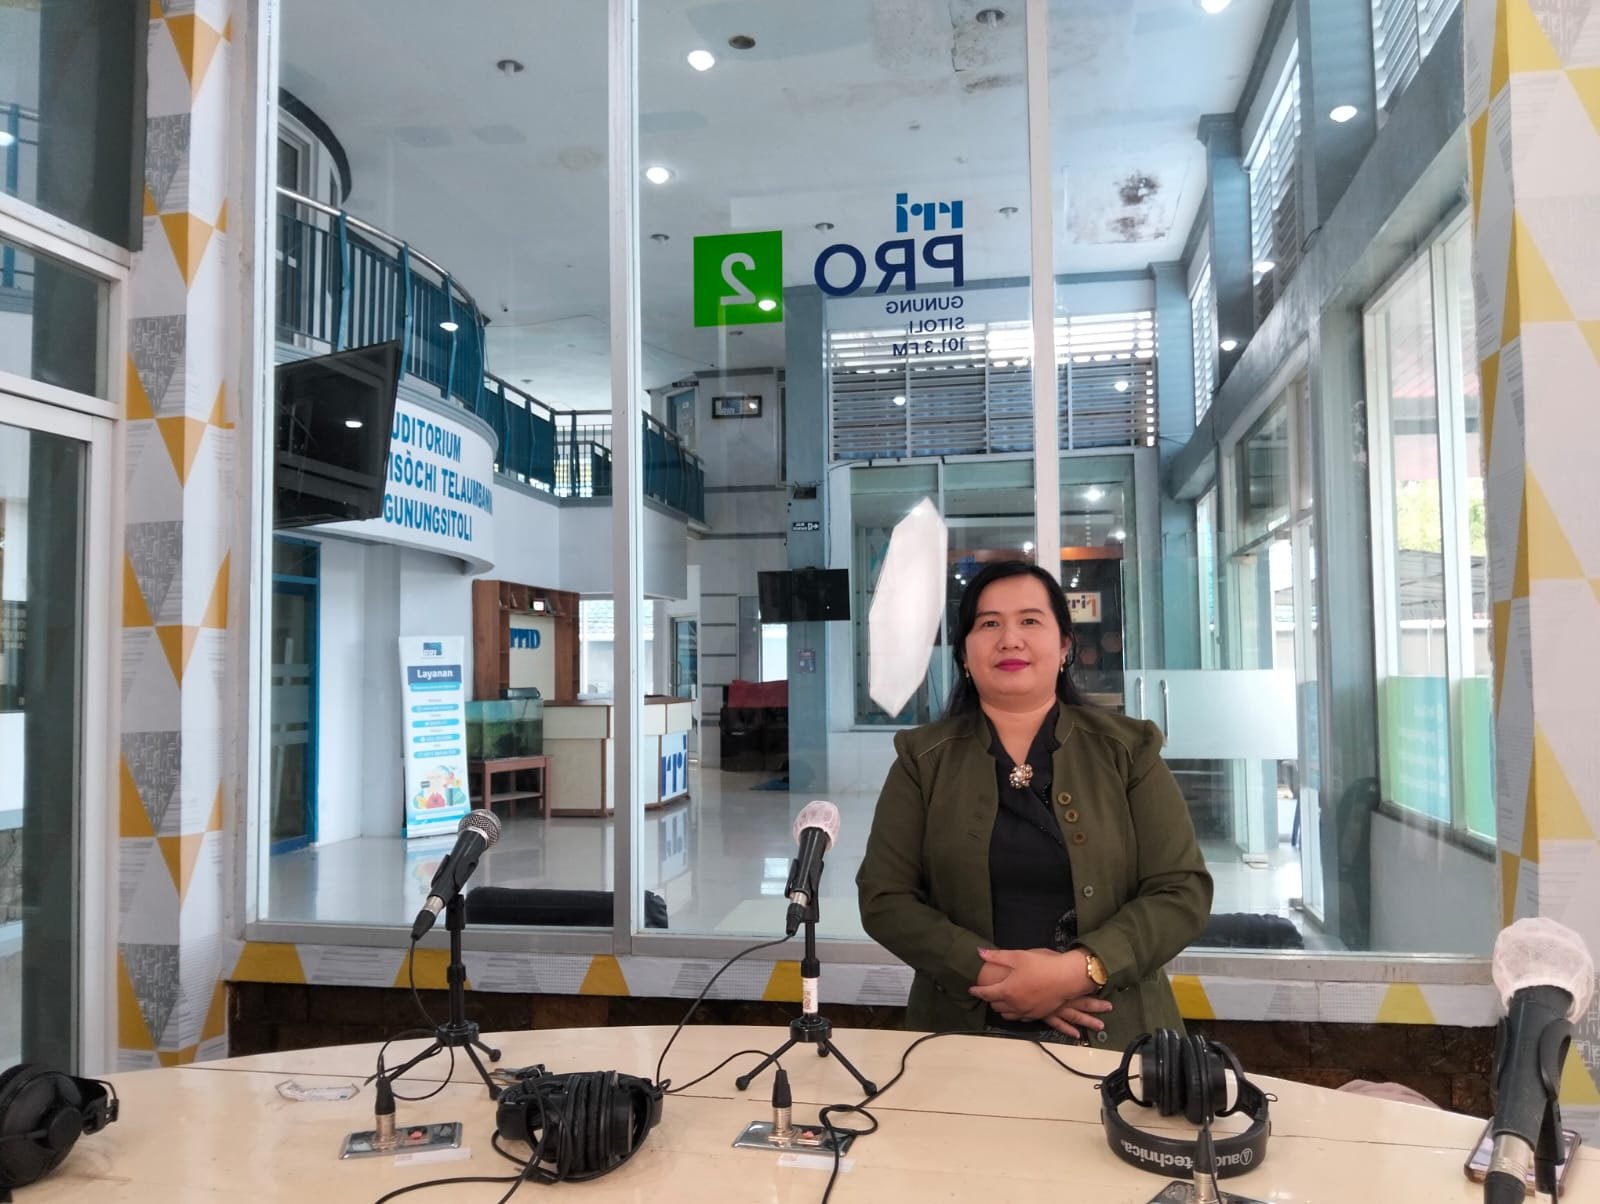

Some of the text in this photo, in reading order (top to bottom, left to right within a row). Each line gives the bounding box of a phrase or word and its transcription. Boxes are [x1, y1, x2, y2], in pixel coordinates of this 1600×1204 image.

[391, 411, 462, 463] UDITORIUM
[384, 493, 472, 542] GUNUNGSITOLI
[416, 669, 454, 680] Layanan
[661, 734, 688, 796] rri
